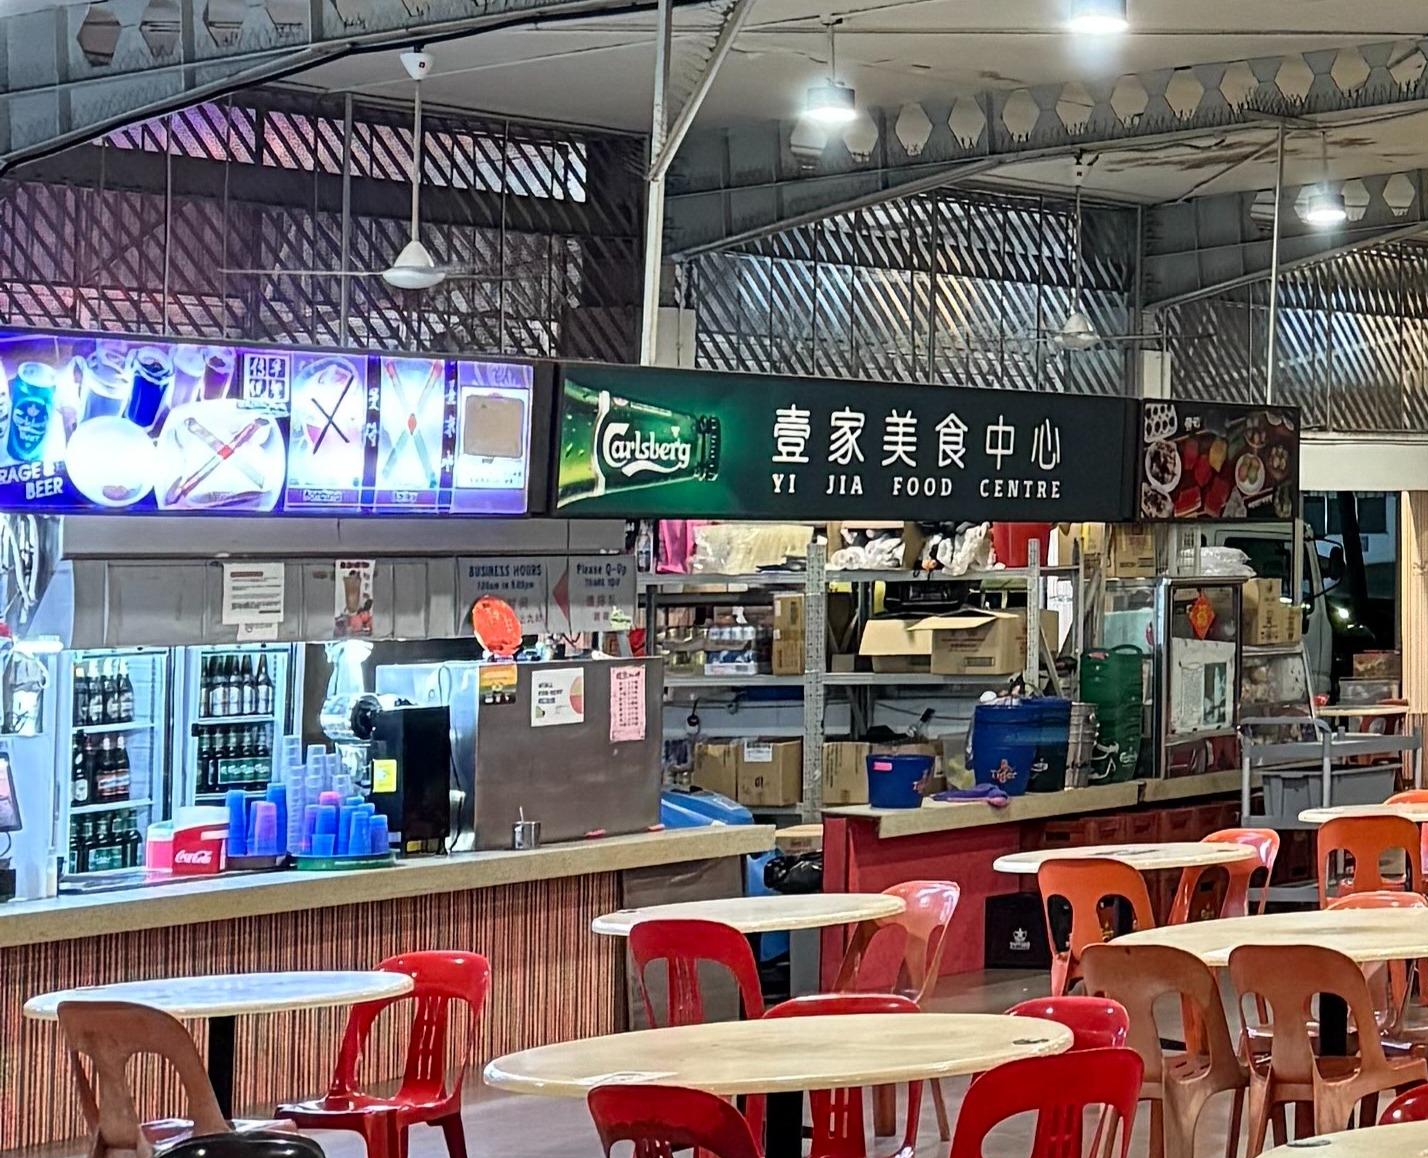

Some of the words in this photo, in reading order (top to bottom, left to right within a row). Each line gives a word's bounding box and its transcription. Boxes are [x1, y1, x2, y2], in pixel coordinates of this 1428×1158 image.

[603, 422, 691, 467] Carlsberg
[771, 402, 1061, 472] 壹家美食中心
[25, 476, 64, 500] BEER
[772, 474, 797, 495] YI
[826, 475, 864, 496] JIA
[893, 476, 953, 497] FOOD
[979, 478, 1062, 500] CENTRE
[469, 564, 510, 578] BUSINESS
[513, 564, 542, 577] HOURS
[577, 563, 603, 575] Please
[991, 769, 1018, 780] Tiger
